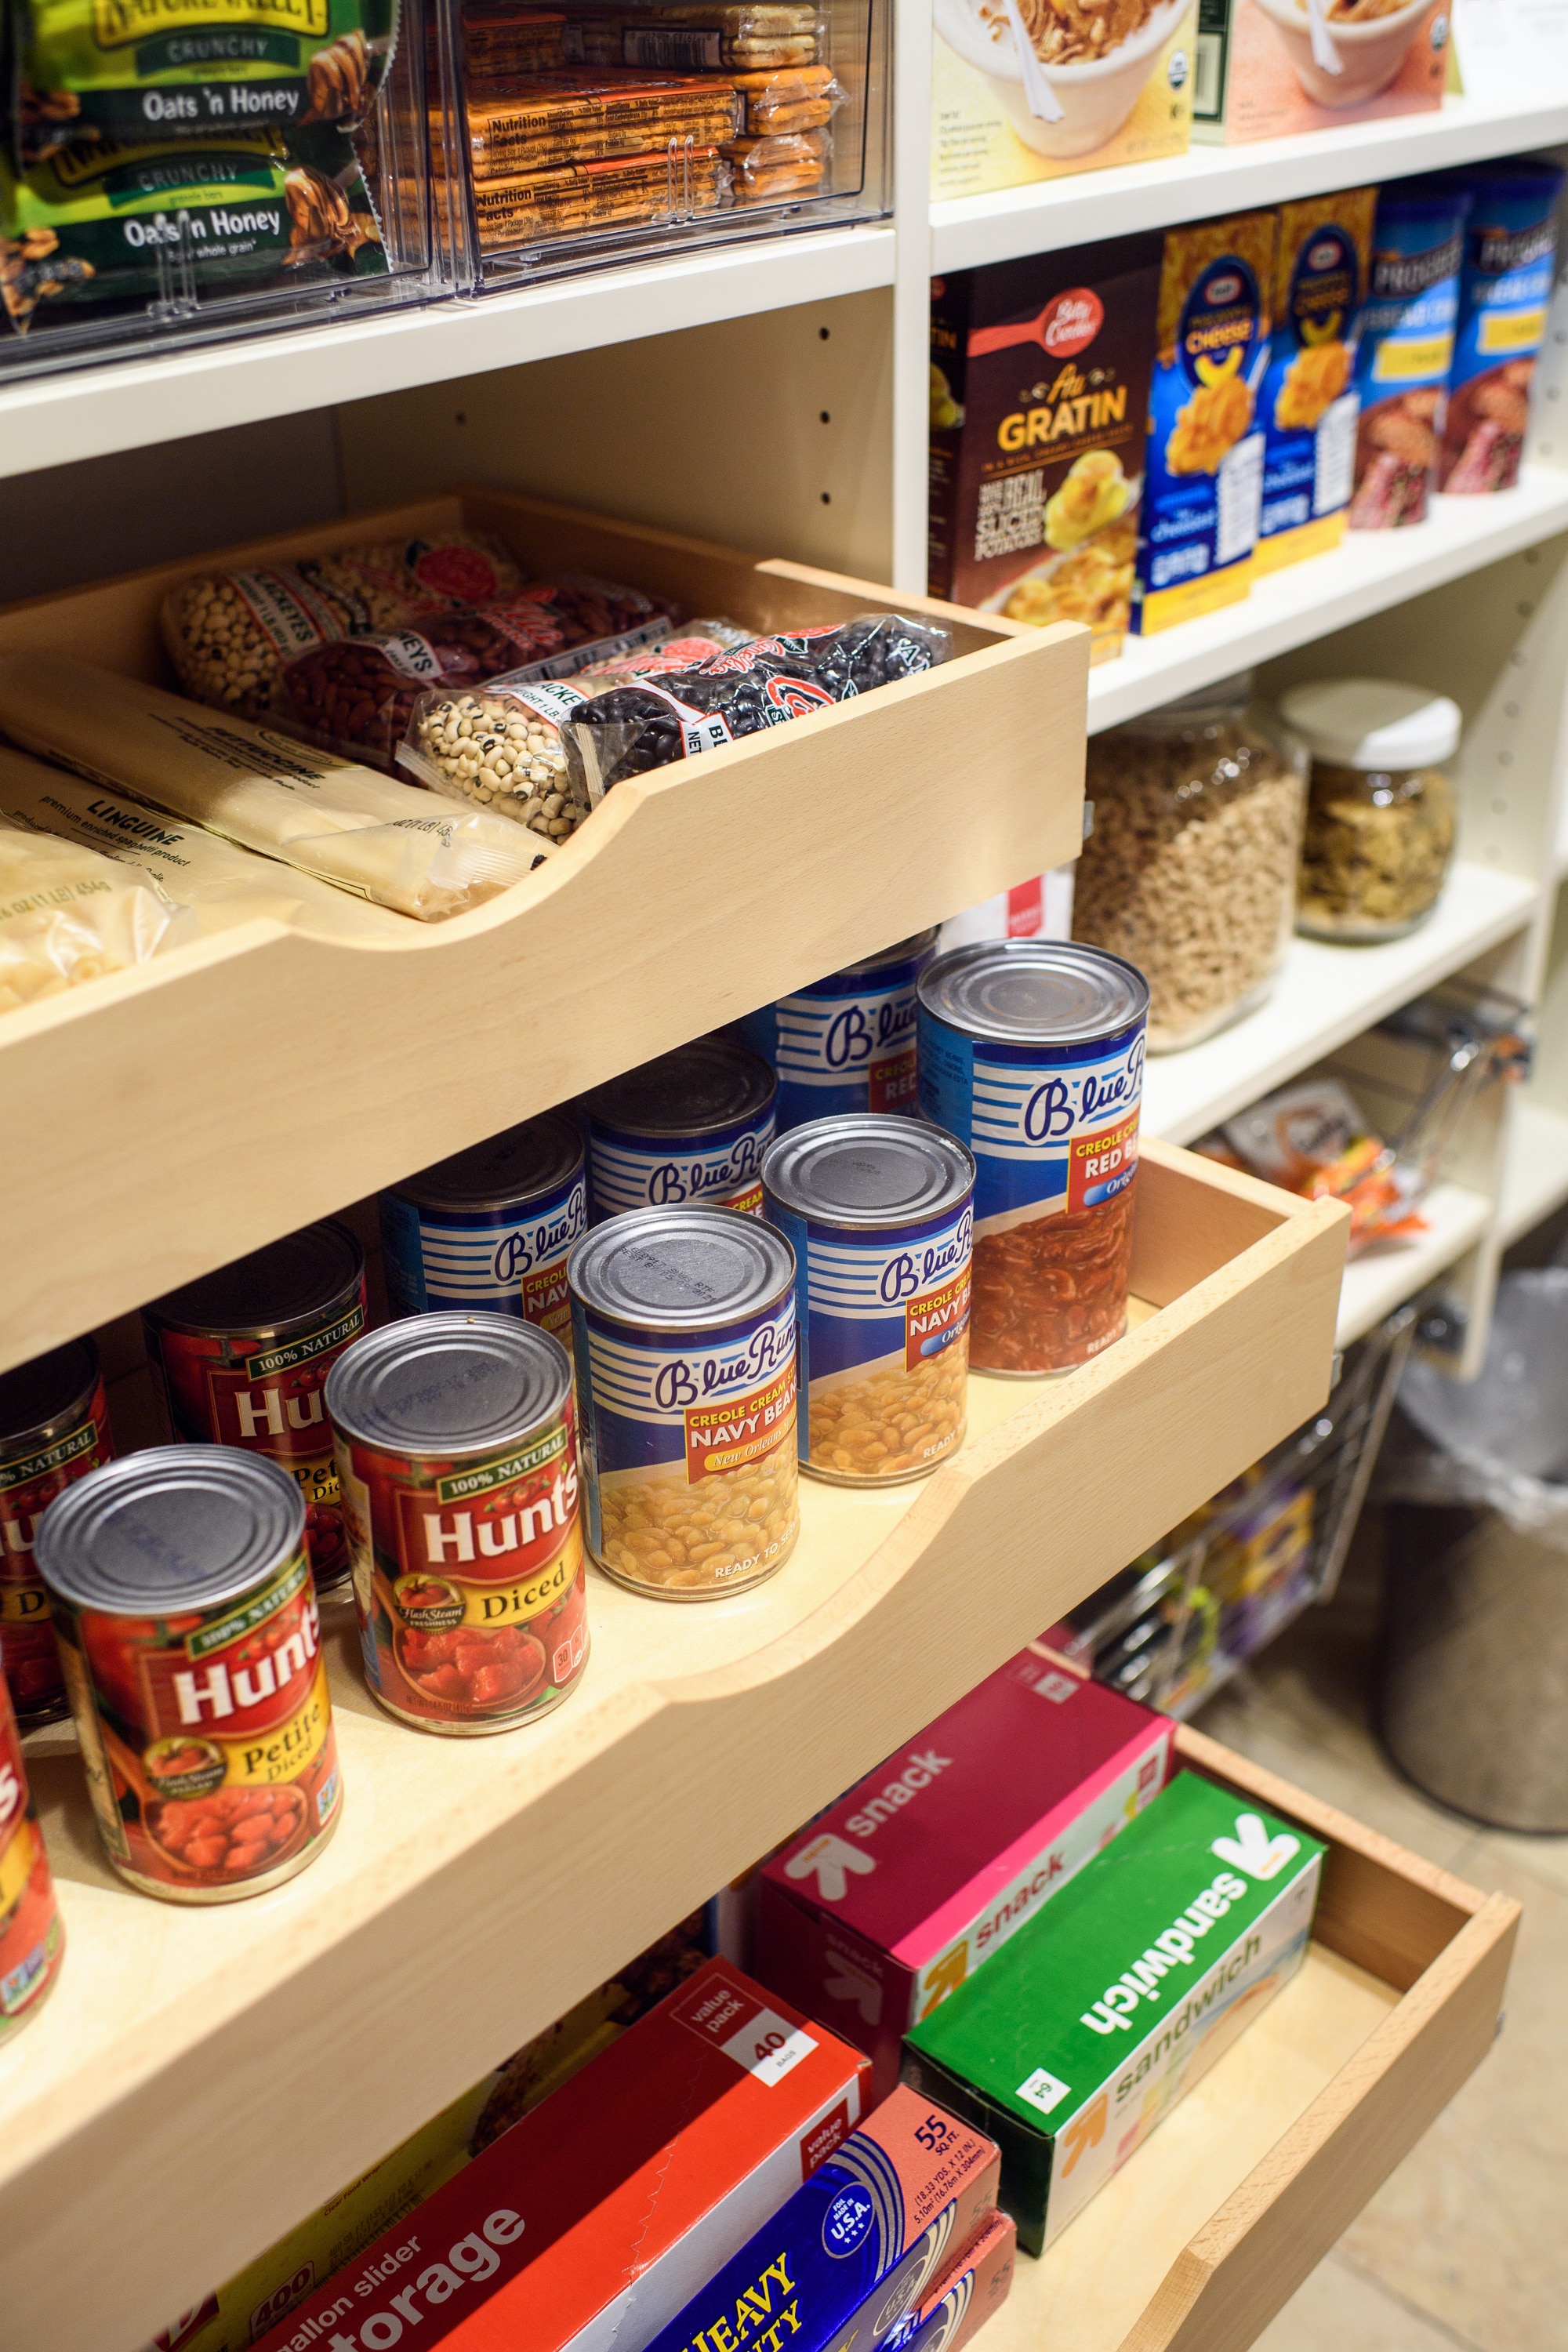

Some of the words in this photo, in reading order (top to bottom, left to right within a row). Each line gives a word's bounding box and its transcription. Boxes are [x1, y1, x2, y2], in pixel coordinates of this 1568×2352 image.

[165, 35, 269, 63] CRUNCHY
[142, 90, 199, 121] Oats
[230, 85, 299, 116] Honey
[492, 115, 546, 133] Nutrition
[492, 133, 528, 147] Facts
[521, 145, 535, 154] Package
[138, 162, 238, 191] CRUNCHY
[476, 188, 532, 208] Nutrition
[209, 209, 281, 236] Honey
[197, 245, 227, 260] whole
[997, 385, 1128, 452] GRATIN
[253, 572, 314, 643] LACKEYES
[397, 631, 434, 674] NEYS
[40, 795, 82, 824] premium
[80, 820, 118, 840] enriched
[115, 833, 154, 857] spaghetti
[154, 848, 191, 868] product
[86, 799, 186, 847] LINGUINE
[12, 899, 31, 915] OZ
[49, 885, 76, 903] LB)
[77, 880, 113, 897] 454g
[1024, 1075, 1127, 1142] Blue
[1076, 1130, 1123, 1159] CREOLE
[1085, 1146, 1123, 1180] RED
[648, 1163, 734, 1206] Blue
[1106, 1165, 1137, 1194] Orig
[494, 1221, 571, 1283] Blue
[880, 1243, 957, 1303] Blue
[527, 1283, 569, 1313] NAV
[909, 1291, 953, 1316] CREOLE
[910, 1294, 961, 1337] NAVY
[258, 1349, 299, 1372] 100%
[302, 1313, 361, 1357] NATURAL
[655, 1359, 751, 1409] Blue
[746, 1325, 797, 1380] Run
[689, 1405, 746, 1428] CREOLE
[750, 1382, 786, 1413] CREAM
[691, 1413, 760, 1449] NAVY
[764, 1378, 797, 1426] BEAN
[20, 1431, 93, 1477] NATURAL
[712, 1452, 742, 1468] New
[744, 1428, 783, 1457] Orleans
[923, 1430, 956, 1459] READY
[292, 1458, 338, 1489] Pet
[450, 1473, 494, 1495] 100%
[497, 1434, 565, 1480] NATURAL
[314, 1481, 339, 1502] Dic
[715, 1552, 761, 1579] READY
[764, 1541, 779, 1559] TO
[781, 1519, 798, 1546] SERV
[481, 1560, 566, 1621] Diced
[557, 1648, 569, 1668] 30
[244, 1702, 321, 1777] Petite
[267, 1737, 313, 1782] Diced
[844, 1747, 955, 1838] snack
[975, 1849, 1065, 1949] snack
[1079, 1872, 1249, 2036] sandwich
[690, 1988, 731, 2024] value
[706, 1998, 745, 2034] pack
[1115, 1933, 1264, 2105] sandwich
[753, 2031, 787, 2061] 40
[775, 2049, 797, 2068] BAGS
[807, 2117, 844, 2154] value
[809, 2130, 843, 2169] pack
[913, 2114, 947, 2151] 55
[946, 2130, 960, 2144] FT.
[914, 2181, 936, 2207] (18.33
[933, 2166, 951, 2184] YDS.
[947, 2158, 956, 2169] X
[954, 2151, 964, 2162] 12
[962, 2138, 976, 2153] IN.)
[934, 2176, 960, 2204] (16.76m
[955, 2168, 964, 2178] X
[960, 2145, 987, 2172] 304mm)
[323, 2198, 343, 2217] Clear
[343, 2181, 362, 2201] Food
[832, 2198, 847, 2212] FOIL
[833, 2203, 850, 2222] MADE
[846, 2197, 855, 2207] IN
[830, 2201, 871, 2240] U.S.A.
[328, 2208, 525, 2352] torage
[353, 2234, 423, 2298] slider
[254, 2267, 311, 2327] 400
